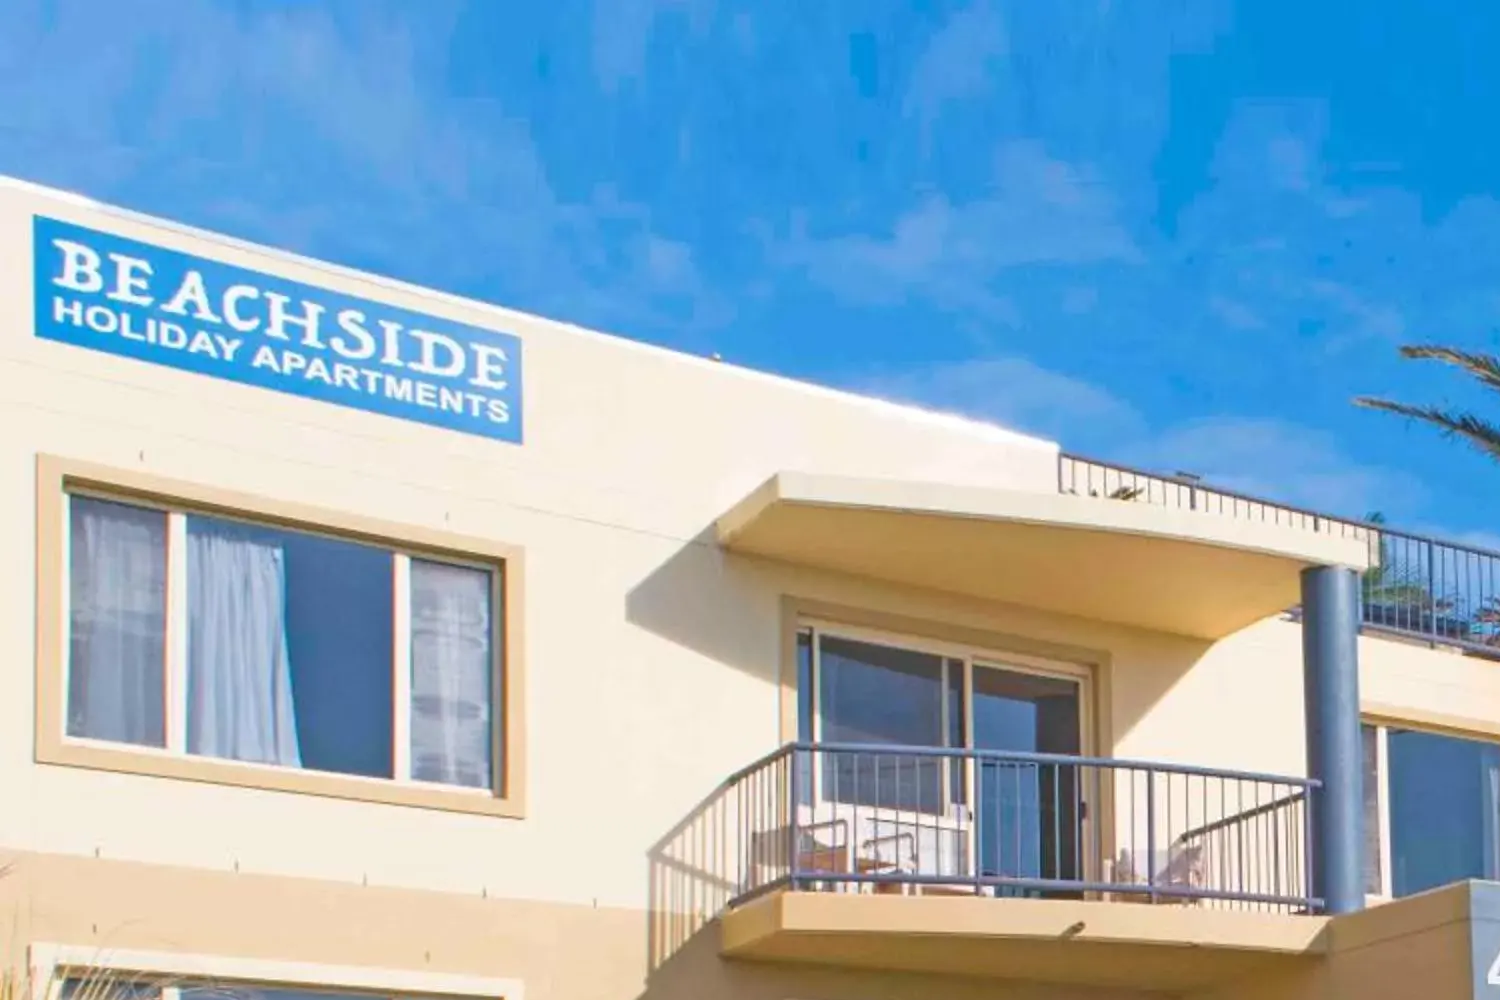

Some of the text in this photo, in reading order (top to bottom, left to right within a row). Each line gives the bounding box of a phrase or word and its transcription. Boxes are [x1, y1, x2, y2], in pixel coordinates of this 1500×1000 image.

[51, 239, 510, 391] BEACHSIDE
[52, 296, 511, 424] HOLIDAY APARTMENTS
